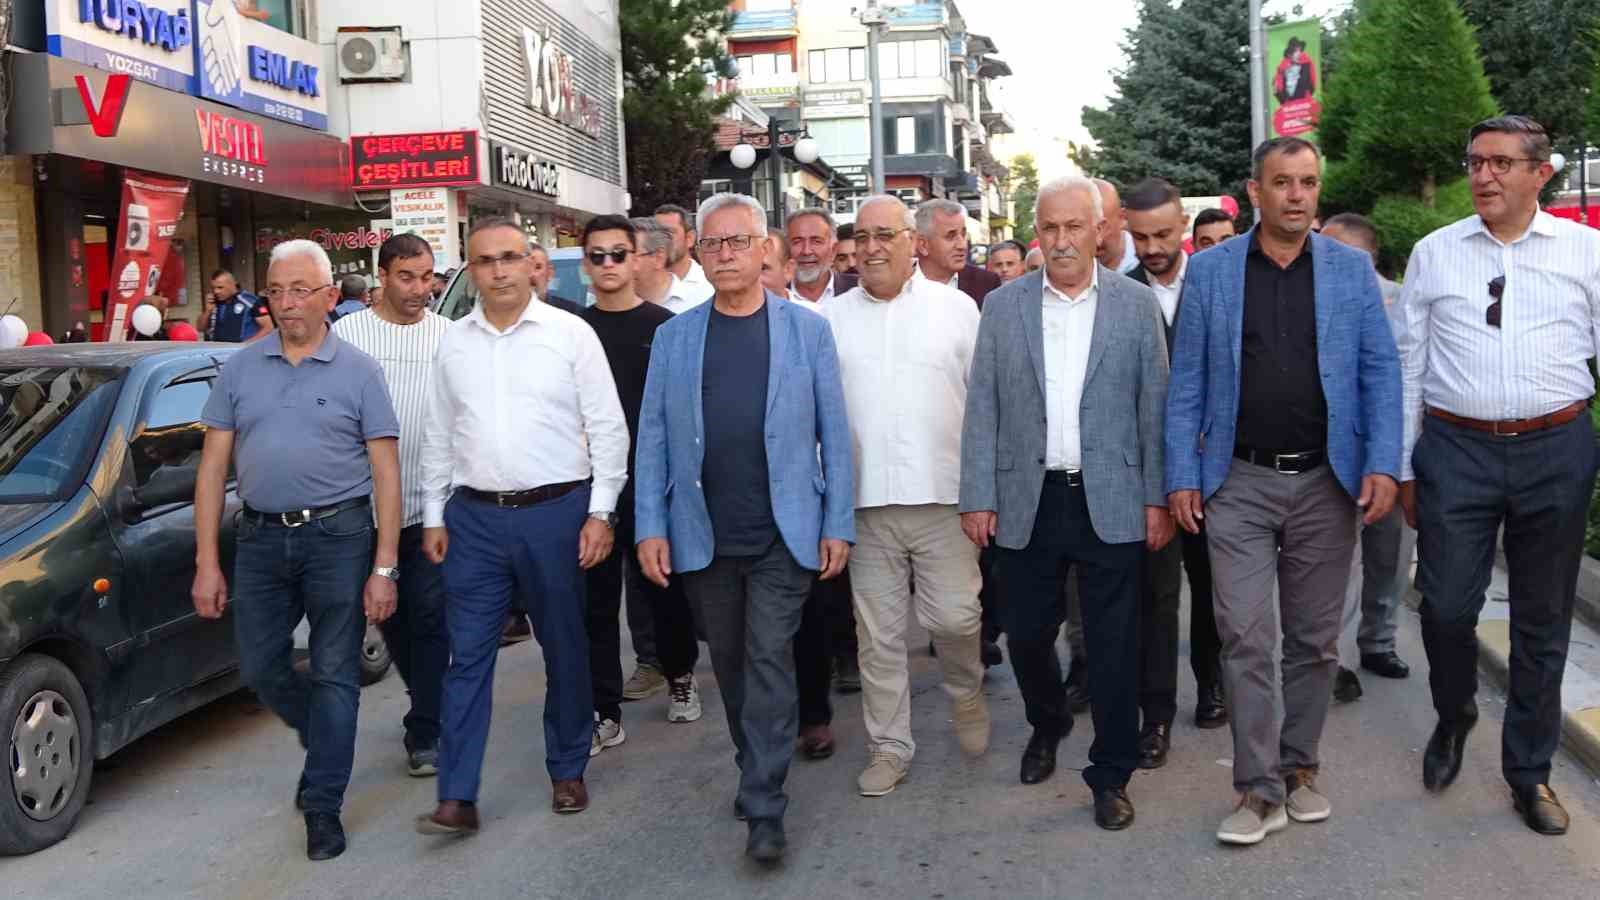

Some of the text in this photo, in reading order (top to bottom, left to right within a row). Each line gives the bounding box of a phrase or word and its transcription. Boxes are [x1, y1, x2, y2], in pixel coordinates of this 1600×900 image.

[104, 53, 159, 81] YOZGAT
[247, 45, 320, 97] EMLAK
[195, 107, 269, 167] VESTEL
[362, 133, 465, 159] ÇERÇEVE
[203, 156, 264, 184] EKSPRES
[358, 155, 470, 185] ÇEŞİTLERİ
